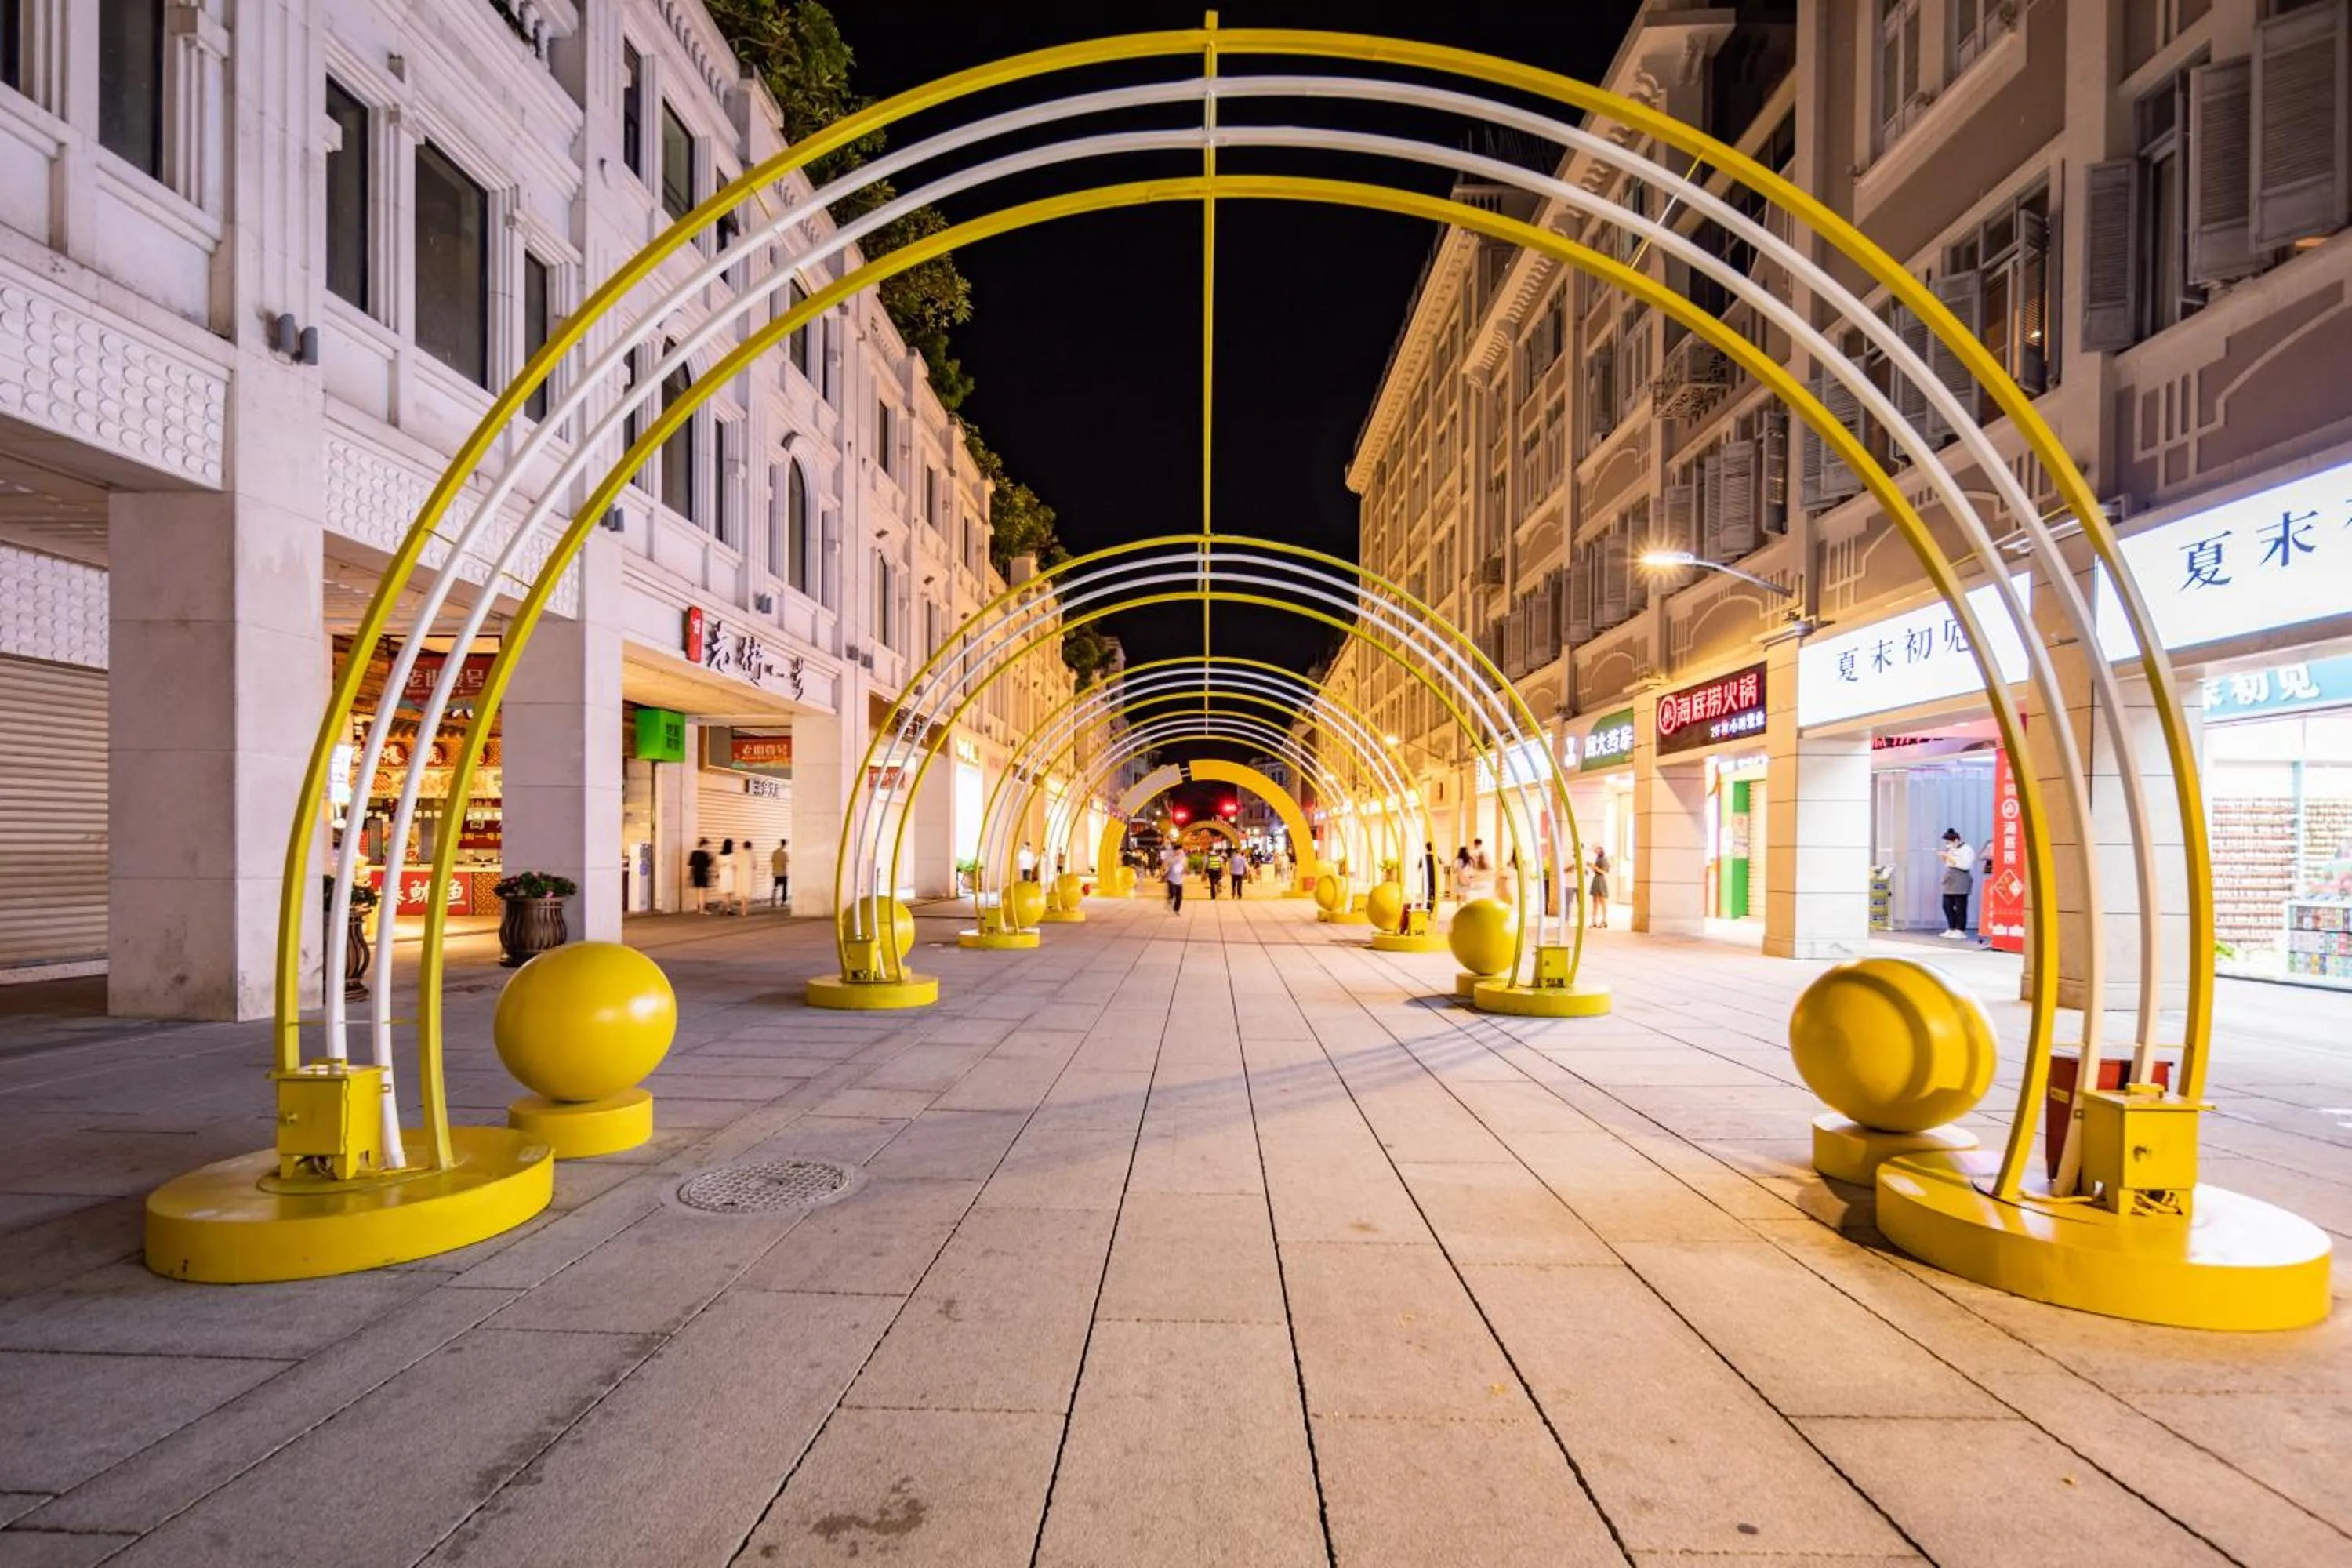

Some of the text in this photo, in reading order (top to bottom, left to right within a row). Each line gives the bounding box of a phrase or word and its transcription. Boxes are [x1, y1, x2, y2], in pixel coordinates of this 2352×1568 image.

[2178, 499, 2352, 592] 夏末
[1836, 619, 1970, 682] 夏末初见
[1676, 673, 1757, 728] 海底捞火锅
